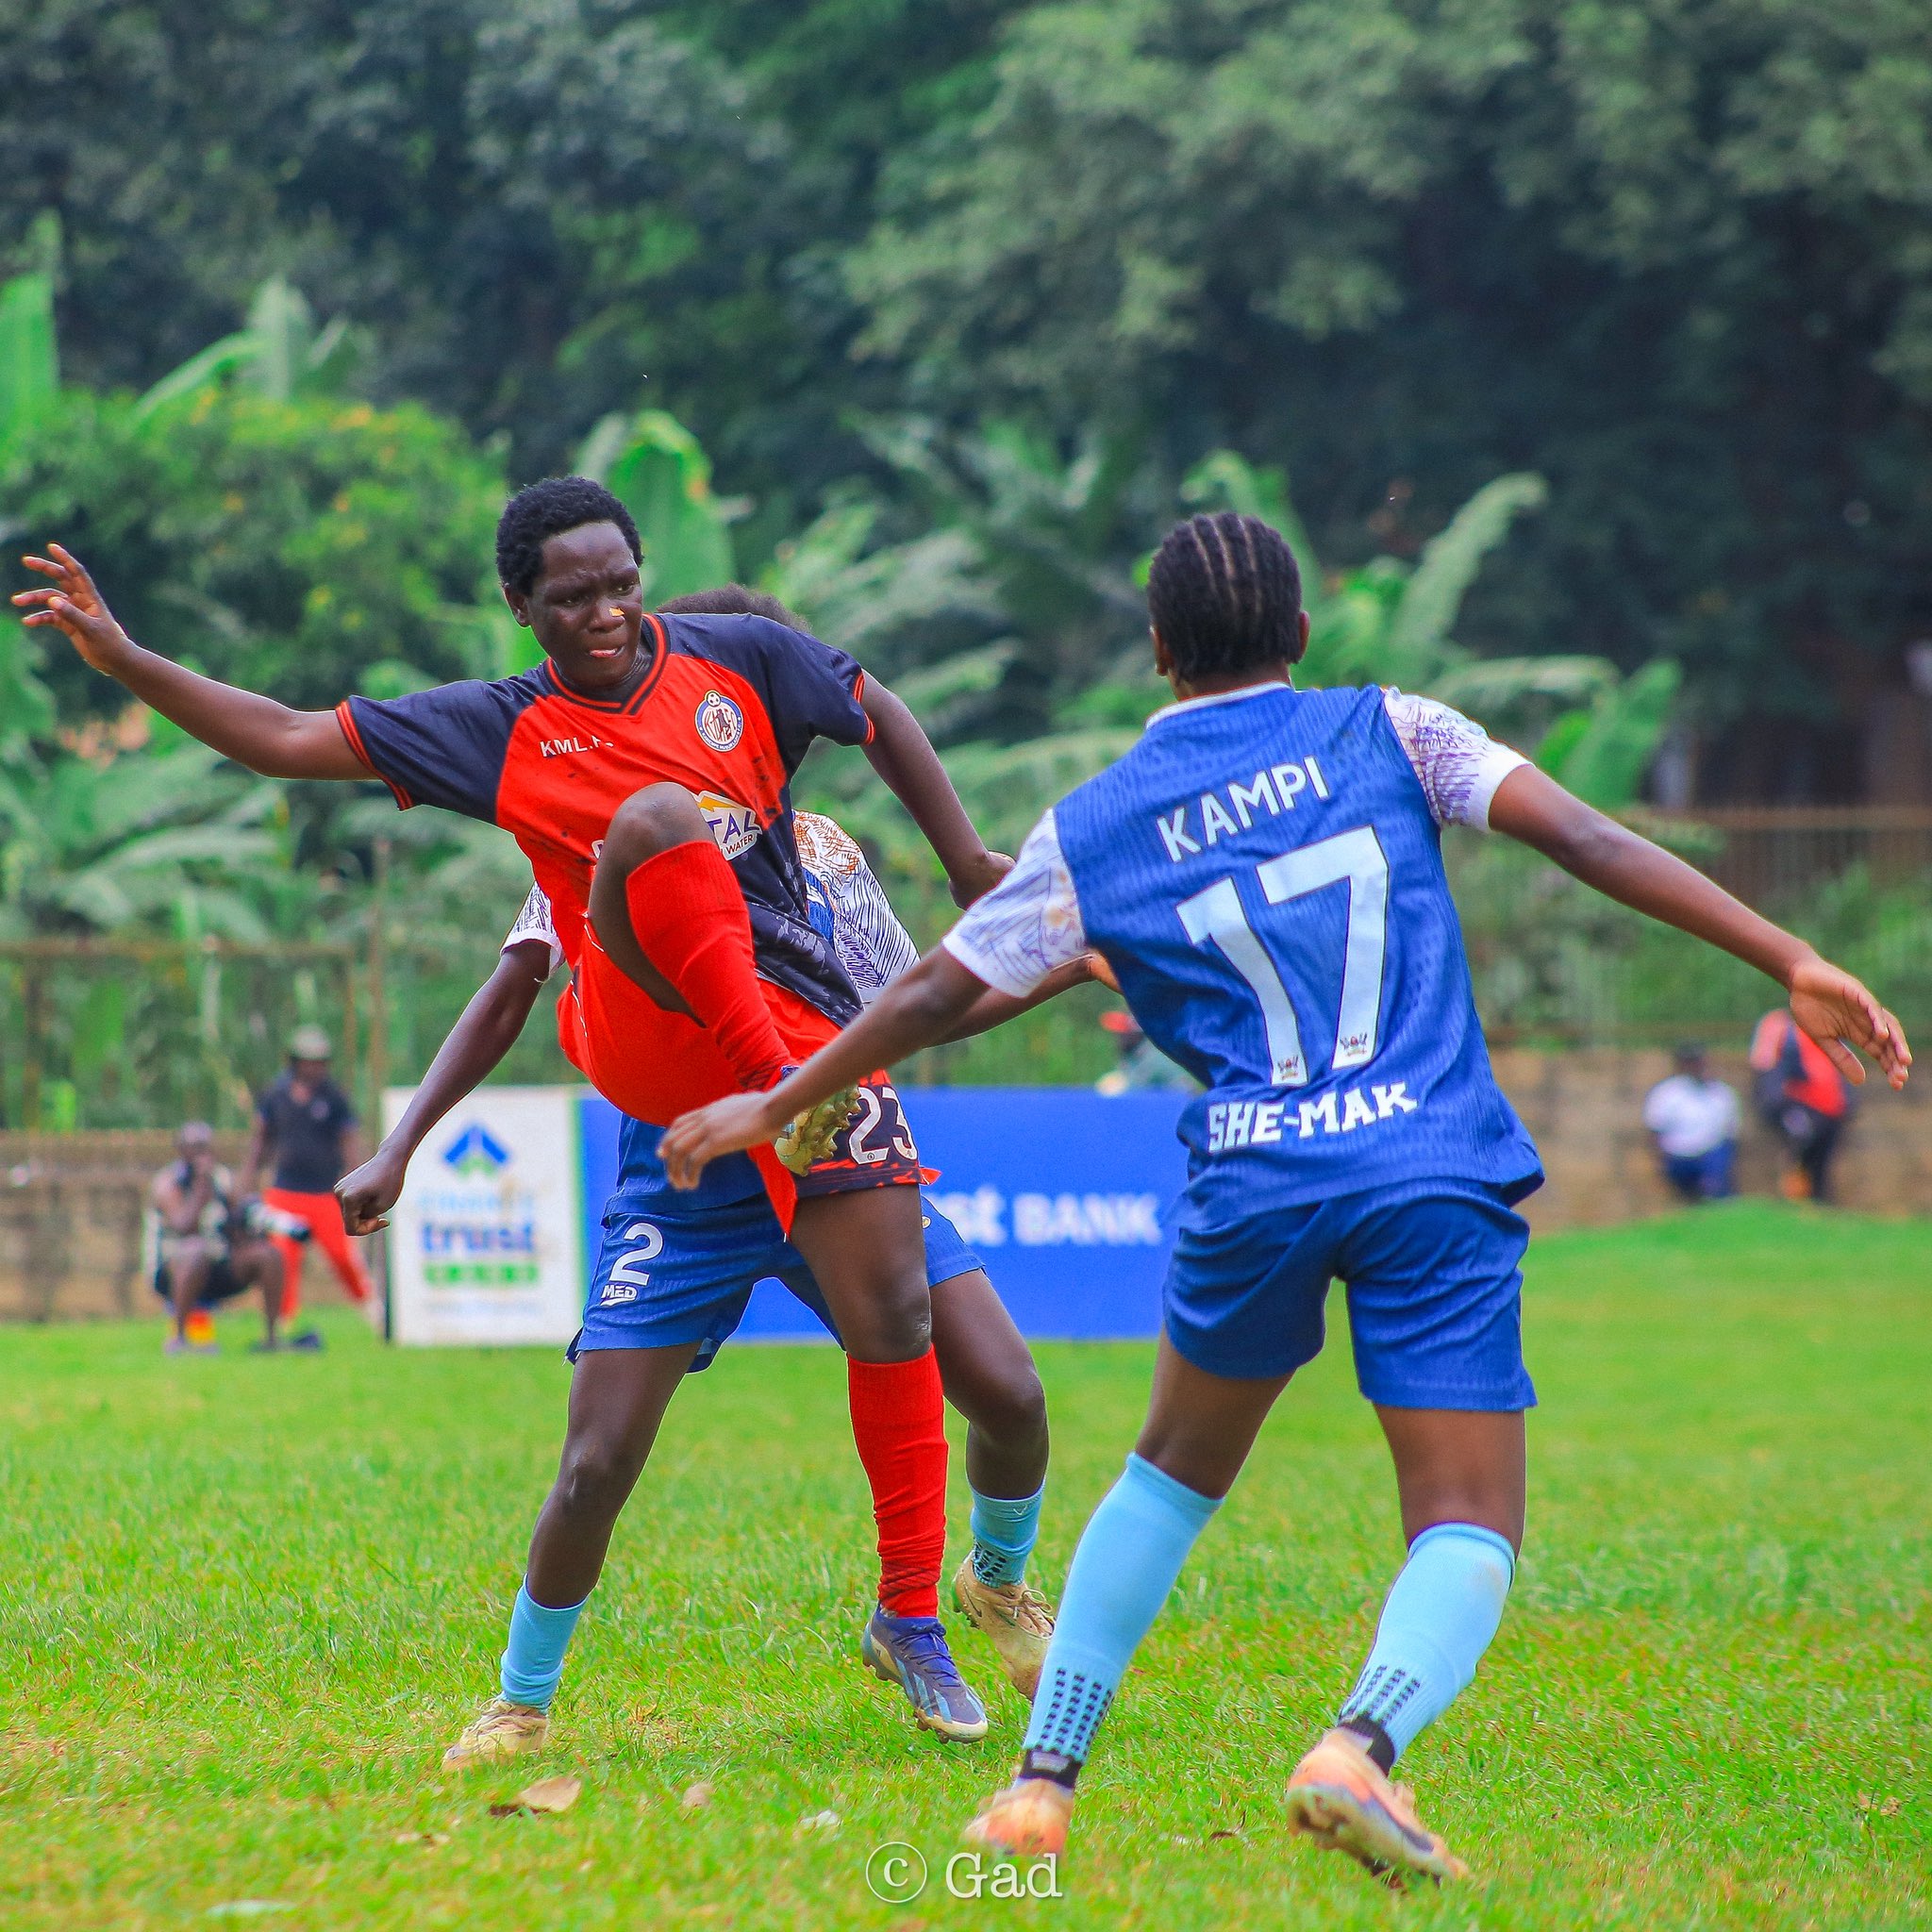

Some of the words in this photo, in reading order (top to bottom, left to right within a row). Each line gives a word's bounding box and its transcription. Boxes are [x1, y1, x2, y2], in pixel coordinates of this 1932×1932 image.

[1157, 756, 1329, 863] KAMPI
[725, 834, 754, 855] WATER
[1175, 824, 1389, 1086] 17
[848, 1086, 918, 1165] 23
[1208, 1082, 1418, 1154] SHE-MAK
[1013, 1191, 1163, 1247] BANK
[608, 1223, 663, 1286] 2
[601, 1284, 638, 1300] MED
